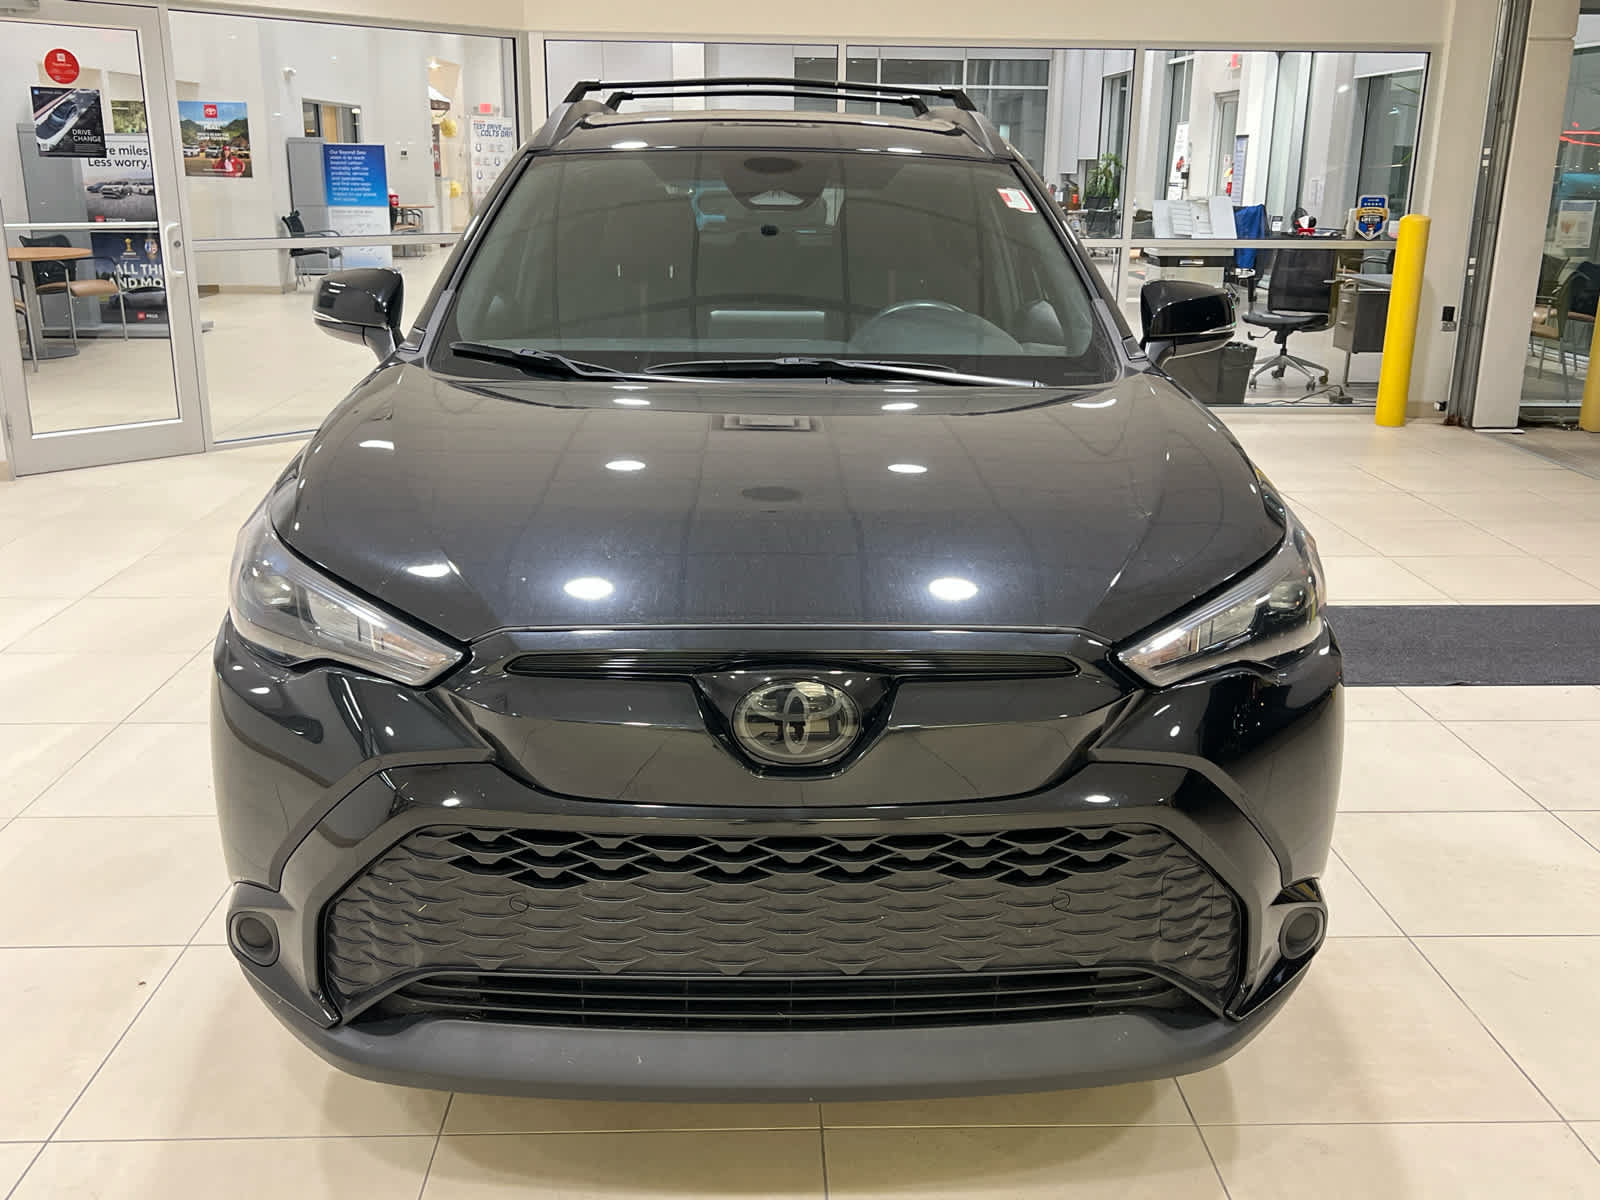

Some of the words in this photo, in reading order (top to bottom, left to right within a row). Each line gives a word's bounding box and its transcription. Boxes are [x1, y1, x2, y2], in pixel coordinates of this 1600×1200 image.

[118, 145, 149, 156] miles
[88, 157, 112, 167] Less
[114, 158, 150, 169] worry.
[114, 262, 138, 275] ALL
[140, 264, 163, 276] THI
[109, 278, 140, 289] AND
[141, 278, 164, 289] MO
